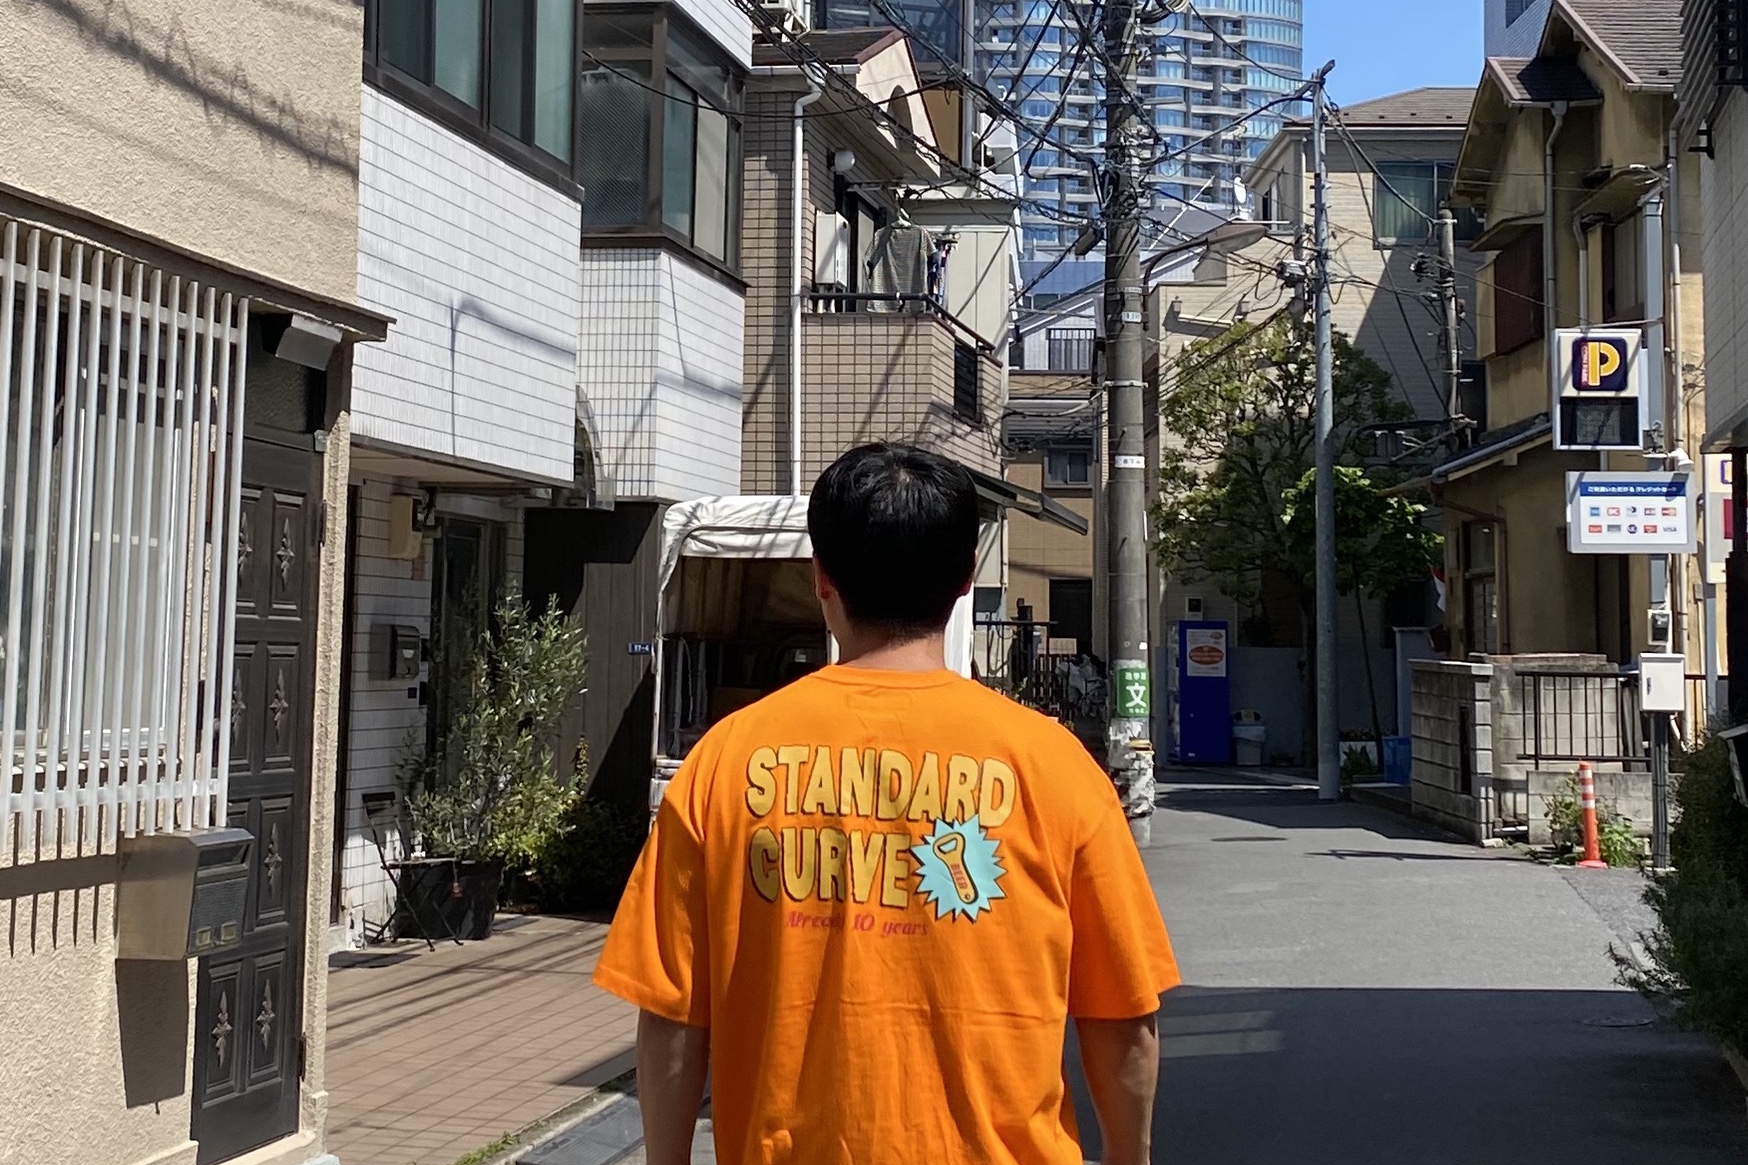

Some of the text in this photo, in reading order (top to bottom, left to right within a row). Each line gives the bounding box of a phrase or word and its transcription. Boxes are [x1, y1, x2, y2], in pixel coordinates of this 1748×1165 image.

[1588, 341, 1620, 387] P
[1125, 682, 1147, 707] 文
[745, 744, 1016, 828] STANDARD
[748, 826, 912, 909] CURVE
[950, 863, 968, 889] BEER
[852, 913, 875, 932] 10
[880, 919, 929, 938] years
